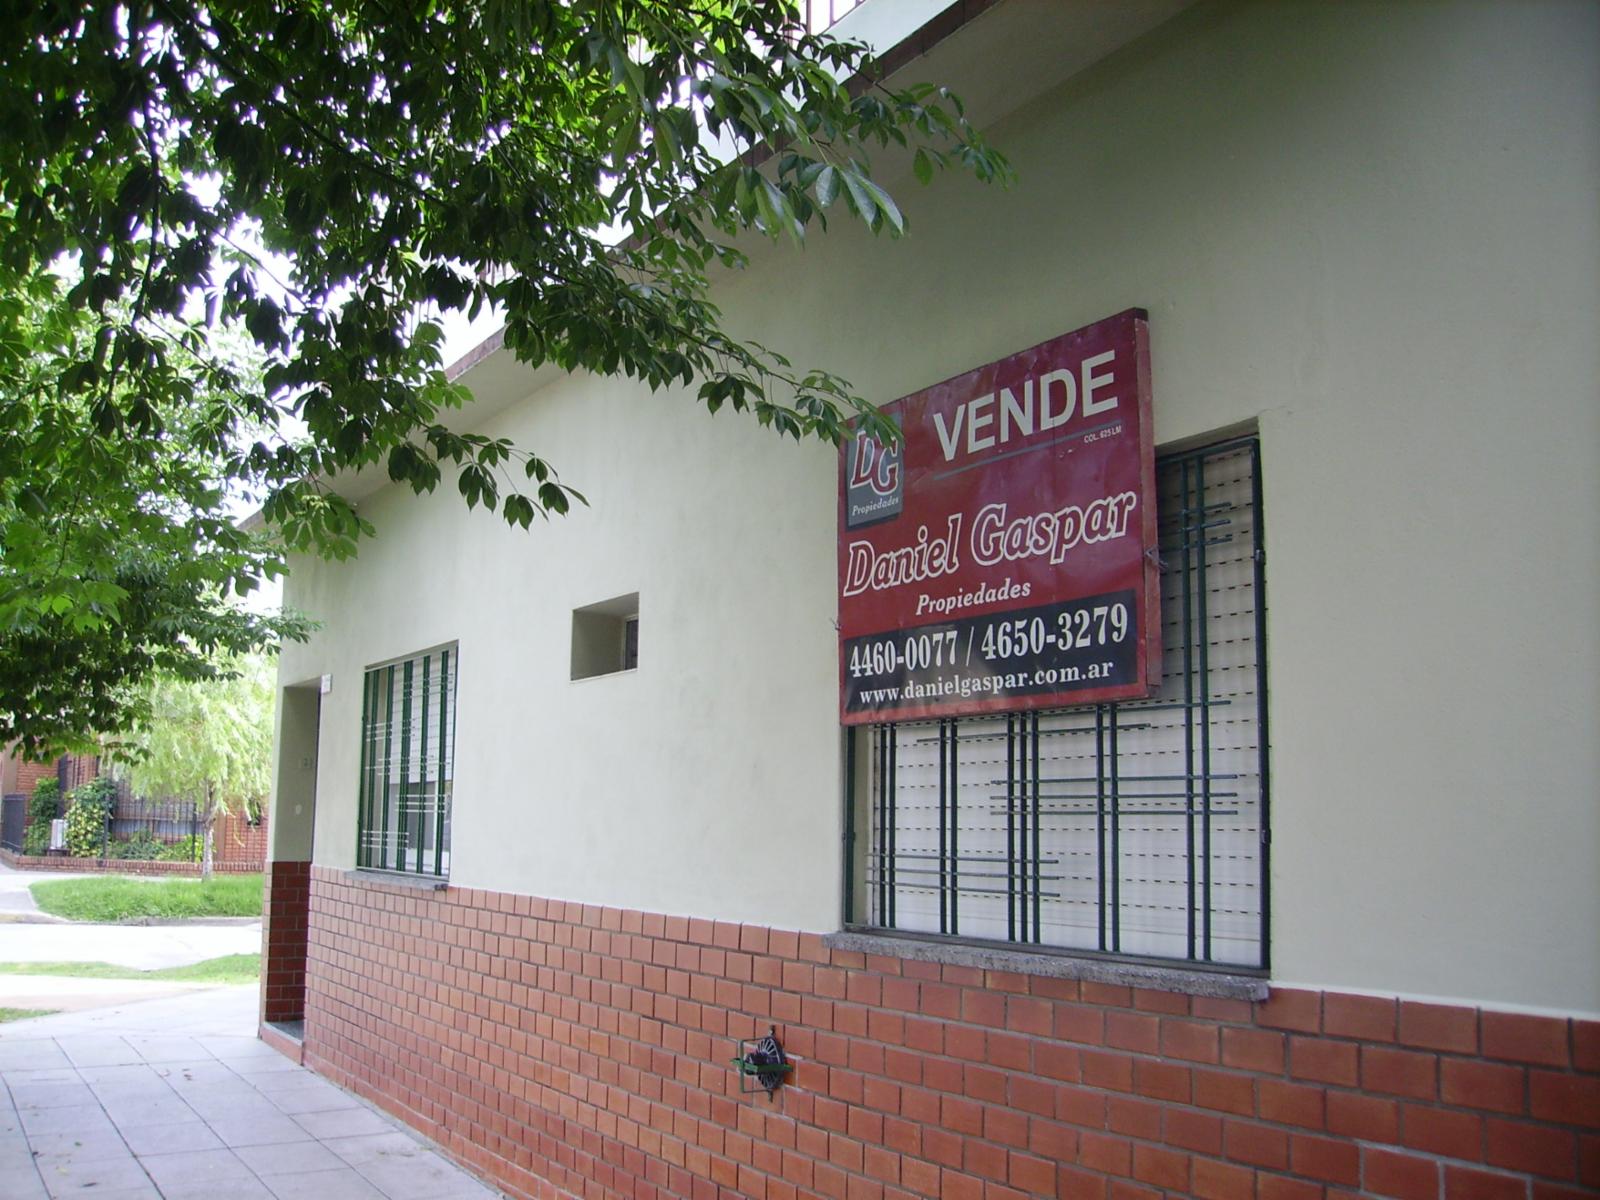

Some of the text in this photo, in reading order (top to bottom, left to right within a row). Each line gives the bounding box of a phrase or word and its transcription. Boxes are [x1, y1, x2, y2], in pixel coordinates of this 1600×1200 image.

[933, 349, 1119, 461] VENDE
[852, 496, 900, 516] Propiedades
[843, 490, 1137, 597] Daniel Gaspar
[916, 578, 1031, 616] Propiedades
[850, 630, 958, 678] 4460-0077
[981, 602, 1128, 660] 4650-3279
[860, 659, 1114, 704] www.danielgaspar.com.ar
